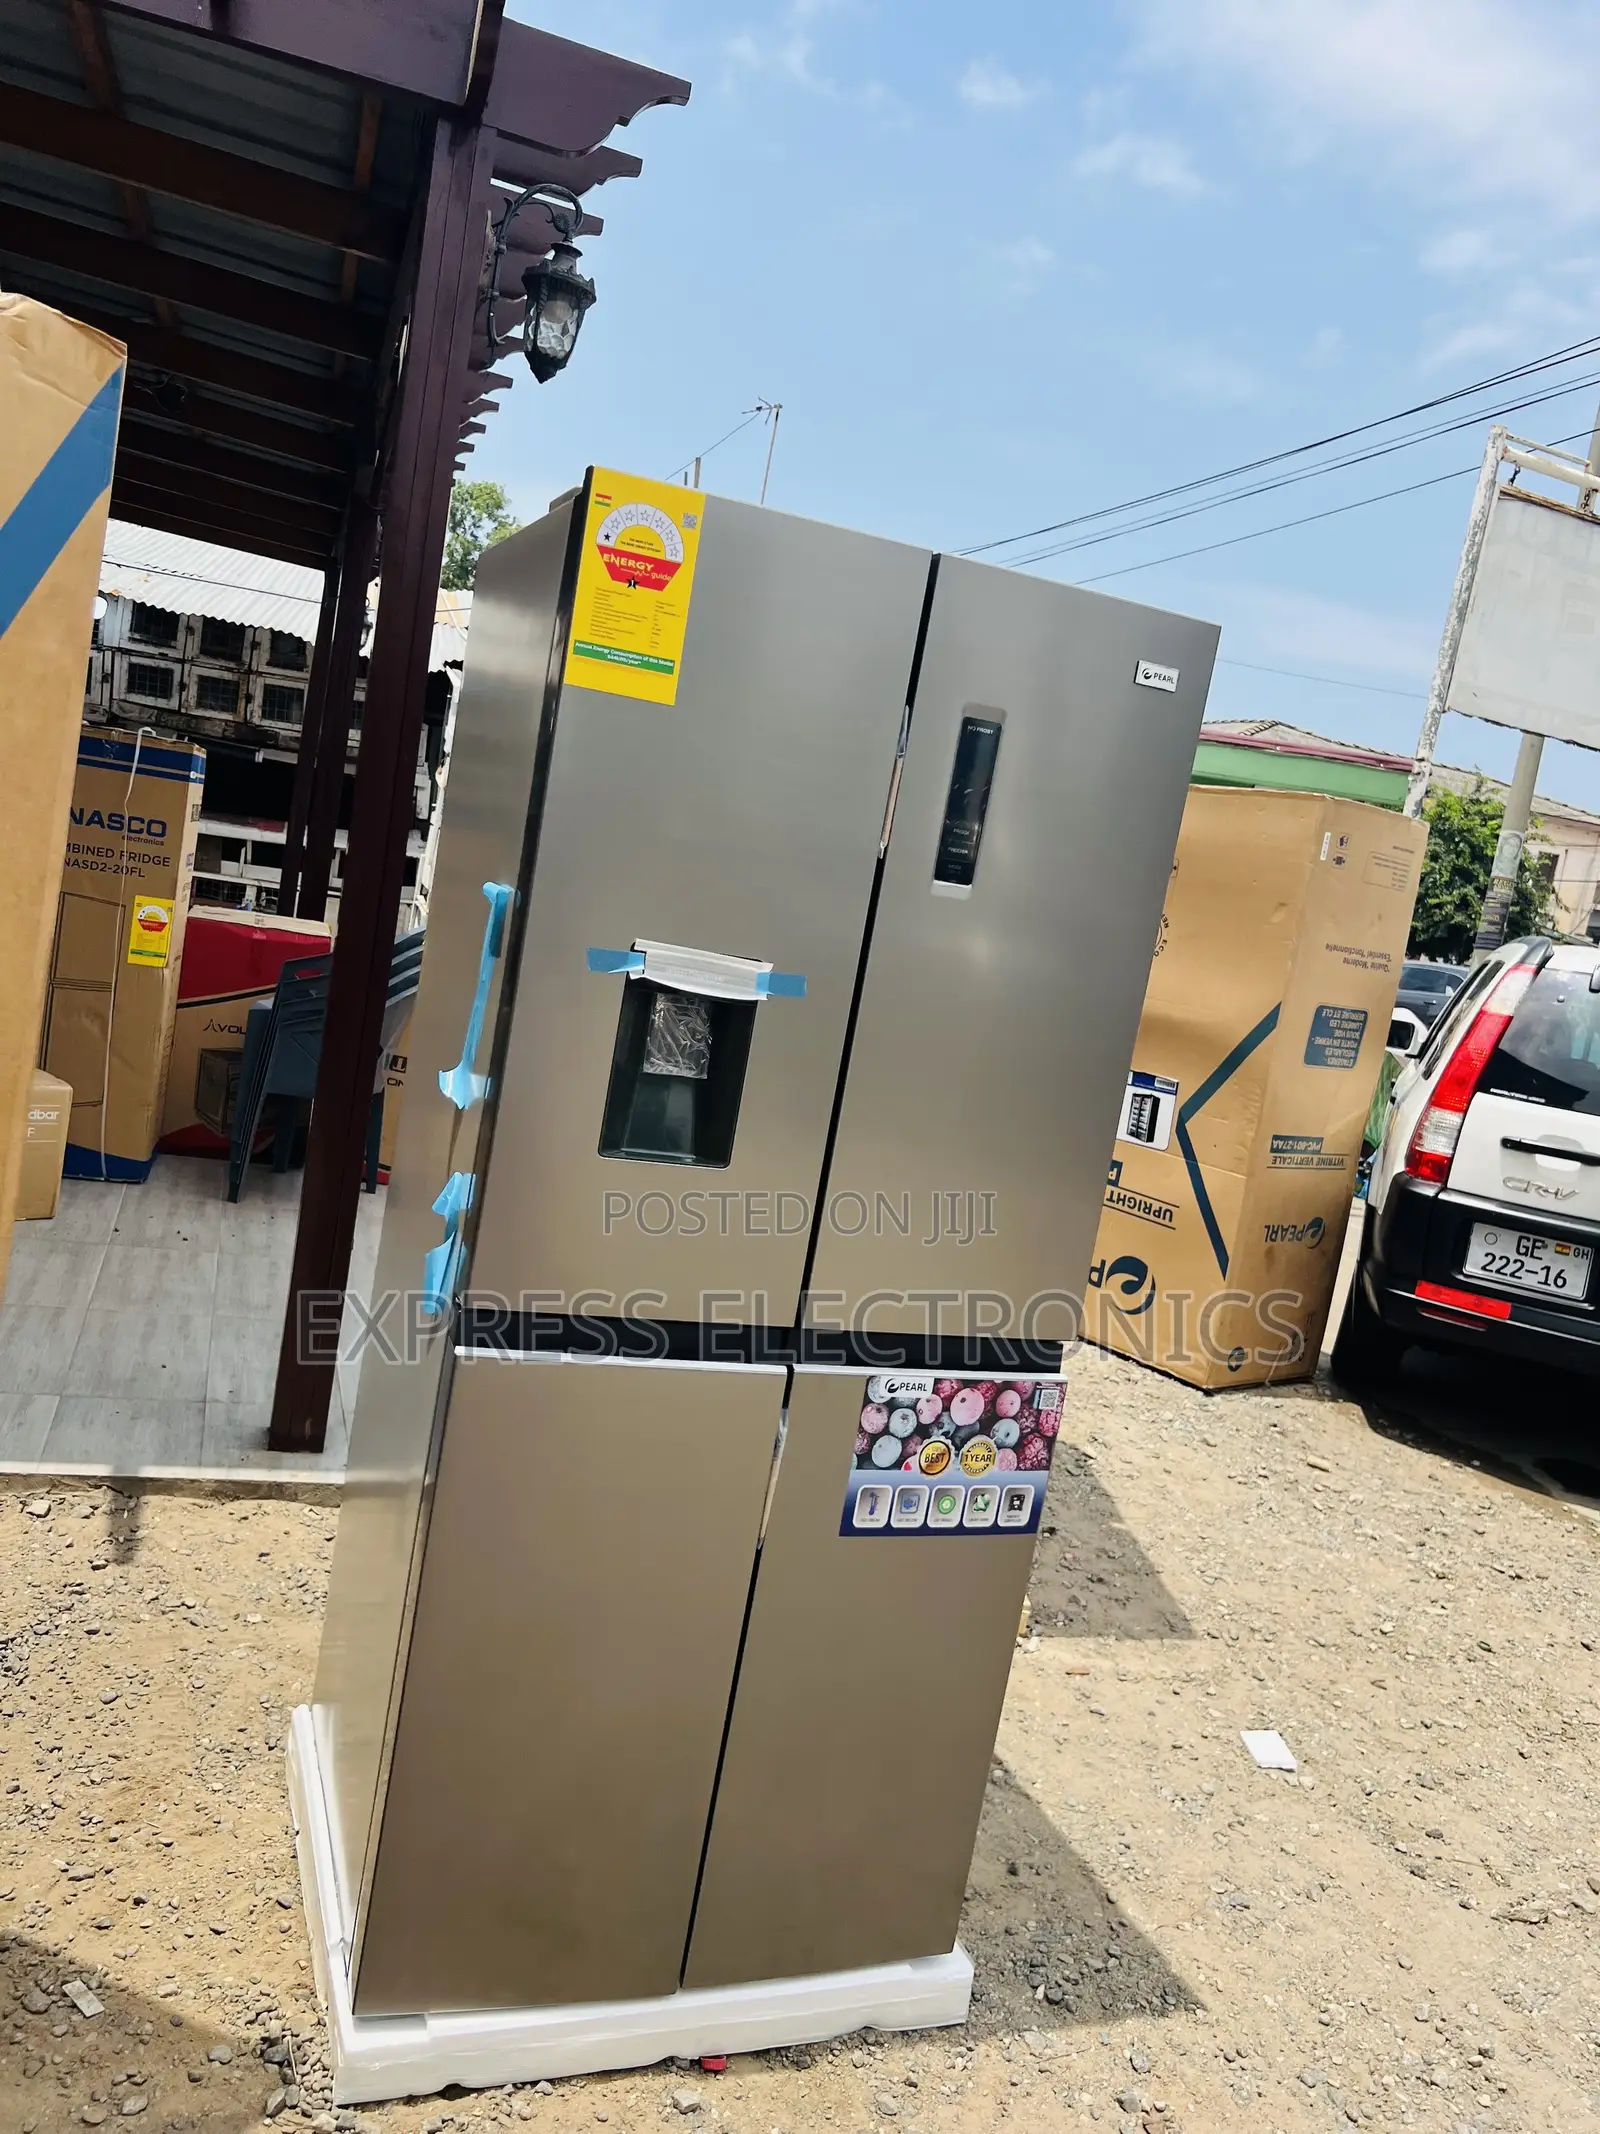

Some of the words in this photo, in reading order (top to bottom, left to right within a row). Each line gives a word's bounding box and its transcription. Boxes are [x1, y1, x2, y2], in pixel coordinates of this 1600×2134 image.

[603, 552, 654, 571] ENERGY
[1153, 672, 1175, 685] PEARL
[70, 807, 167, 838] NASCO
[121, 834, 165, 847] electronics
[119, 850, 171, 867] FRIDGE
[1329, 1019, 1340, 1028] LED
[1271, 1155, 1314, 1166] VERTICALE
[1315, 1156, 1344, 1167] VITRINE
[1106, 1188, 1173, 1223] UPRIGHT
[1264, 1224, 1306, 1243] PEARL
[1515, 1235, 1547, 1261] GE
[1573, 1246, 1591, 1261] GH
[1480, 1252, 1568, 1289] 222-16
[900, 1382, 928, 1392] PEARL
[924, 1452, 948, 1463] BEST
[969, 1453, 992, 1463] YEAR
